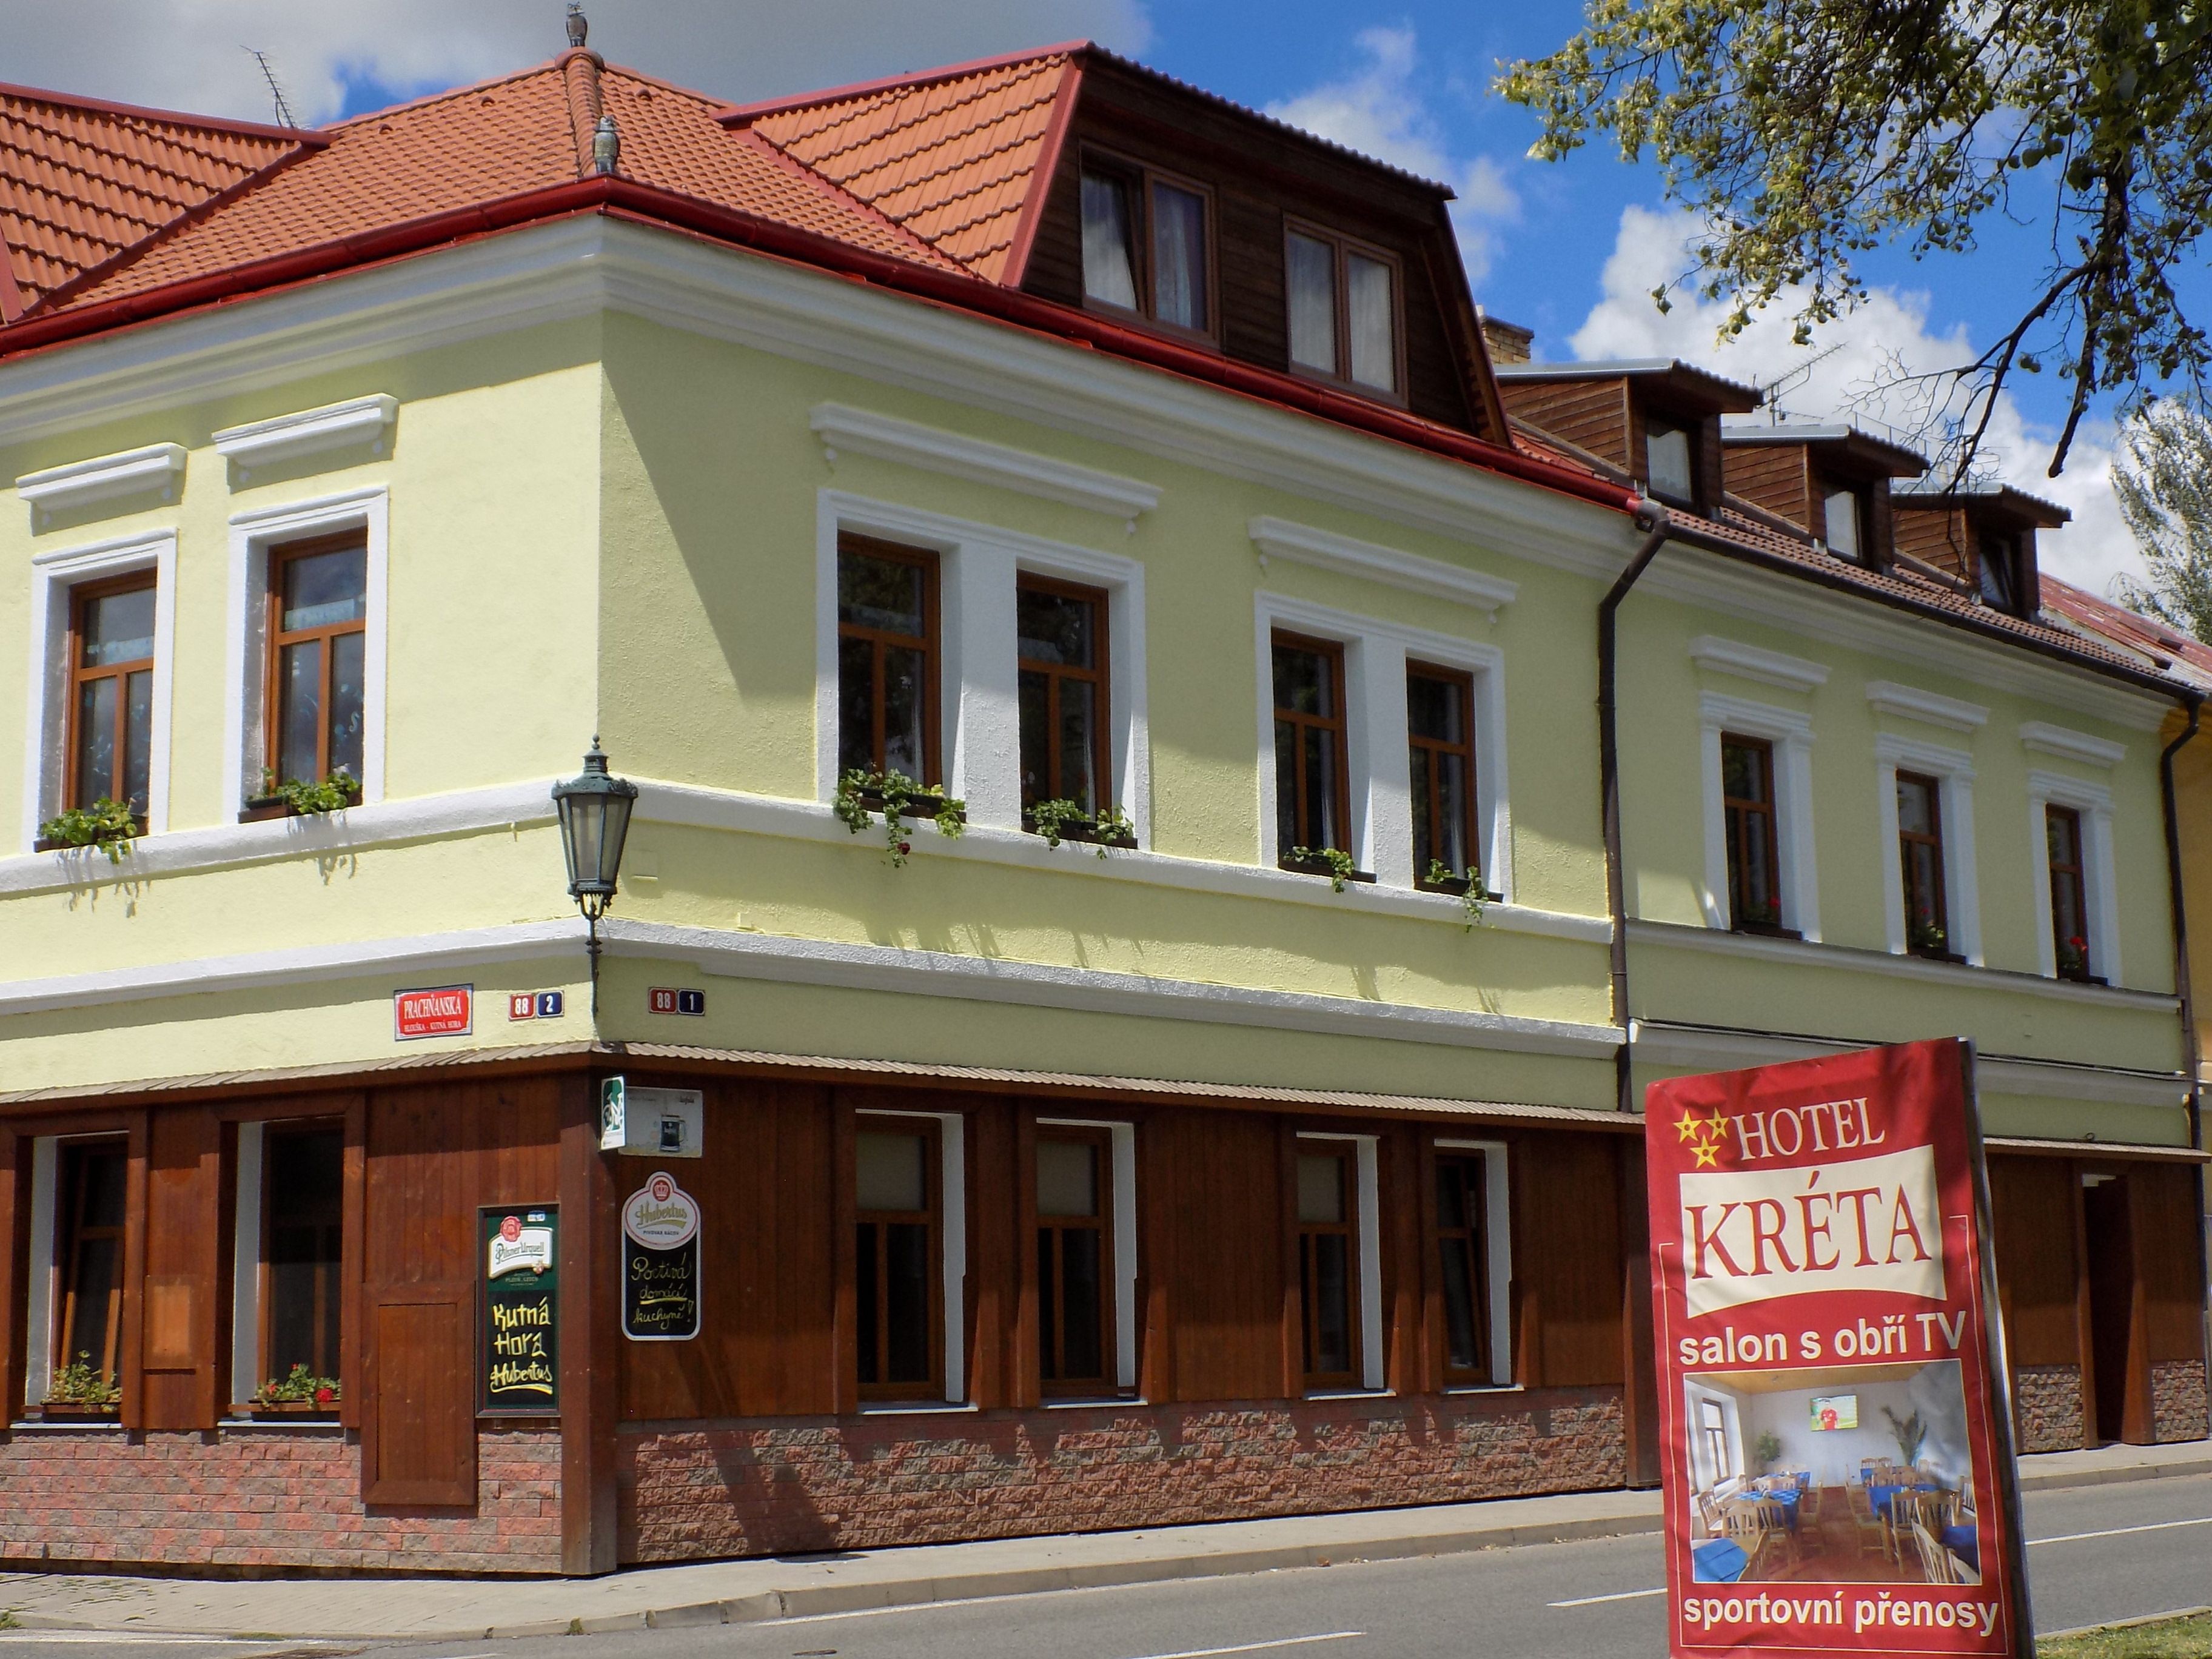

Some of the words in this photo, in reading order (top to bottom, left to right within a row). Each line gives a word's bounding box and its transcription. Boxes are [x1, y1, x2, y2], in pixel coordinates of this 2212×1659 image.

[404, 990, 461, 1019] PRACHŇANSKÁ
[515, 997, 528, 1014] 88
[546, 995, 553, 1013] 2
[657, 992, 671, 1009] 88
[689, 994, 694, 1010] 1
[1732, 1097, 1885, 1161] HOTEL
[635, 1200, 688, 1225] Hubertus
[1685, 1170, 1932, 1279] KRÉTA
[495, 1243, 521, 1265] Pilsner
[520, 1241, 545, 1258] Urquell
[631, 1252, 691, 1281] Poctivá
[492, 1296, 551, 1332] Kutná
[494, 1332, 548, 1357] Hora
[1679, 1326, 1788, 1365] salon
[1800, 1330, 1822, 1359] s
[1834, 1314, 1907, 1358] obří
[1915, 1310, 1966, 1352] TV
[490, 1361, 553, 1386] Hubertus
[1683, 1590, 1843, 1631] sportovní
[1854, 1590, 1999, 1637] přenosy
